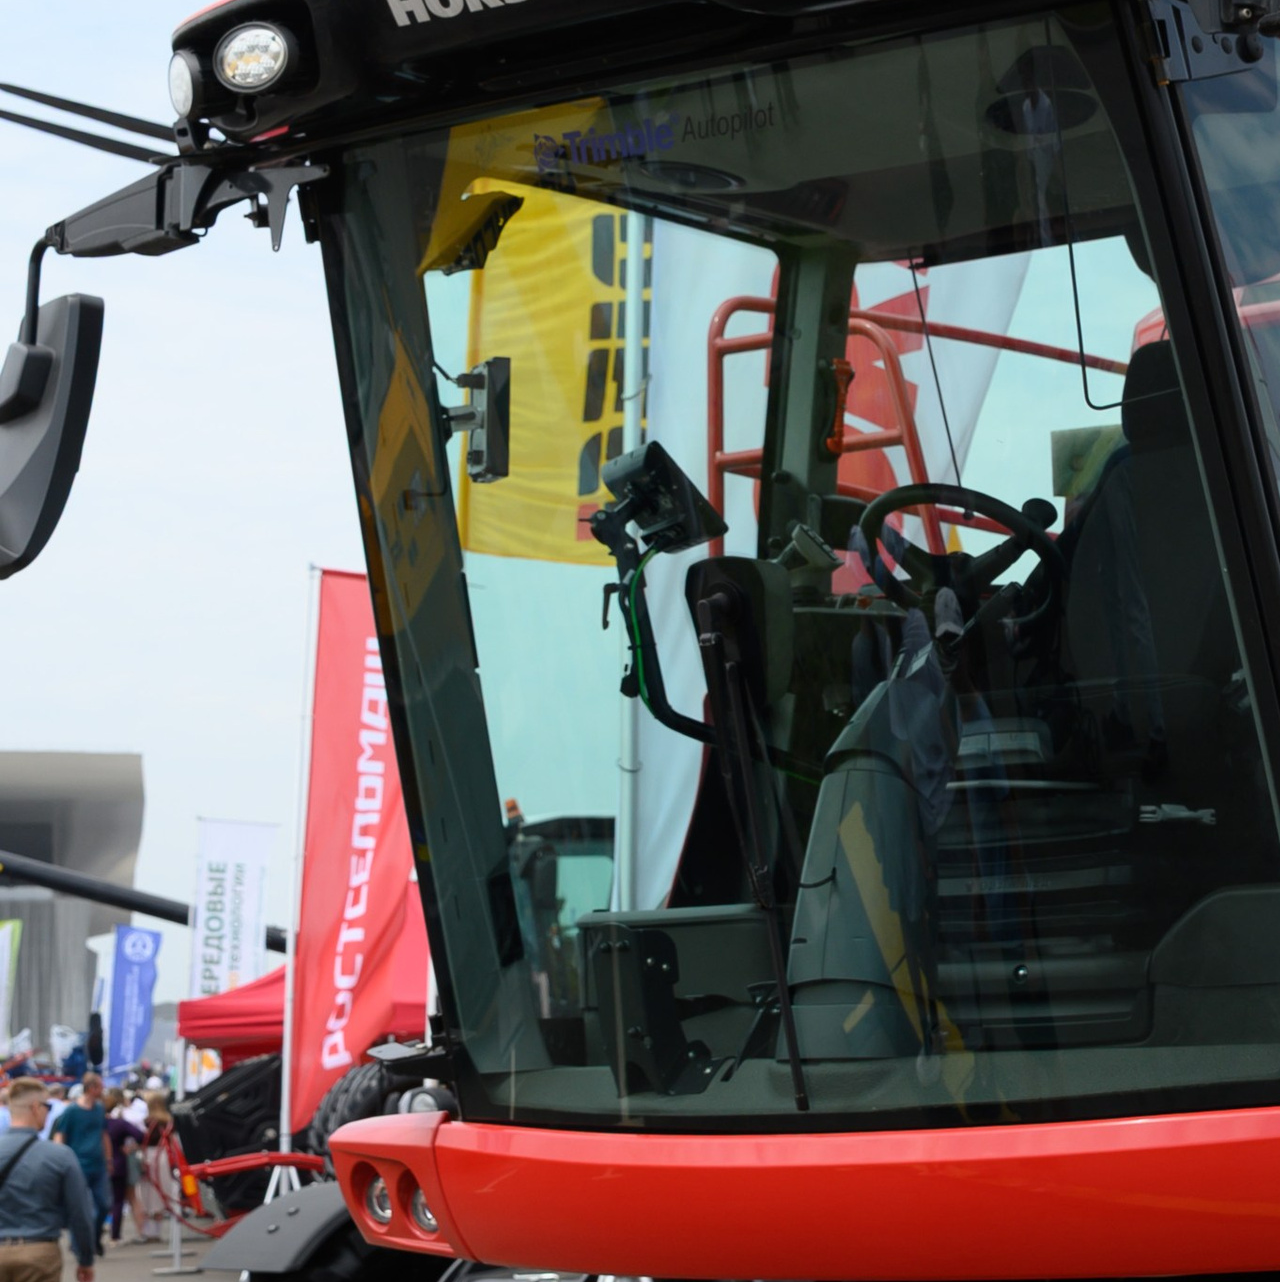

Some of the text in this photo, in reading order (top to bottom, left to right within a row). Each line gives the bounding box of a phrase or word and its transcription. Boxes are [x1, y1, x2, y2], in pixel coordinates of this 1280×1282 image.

[562, 102, 775, 165] Trimble Autopilot
[202, 861, 227, 996] ЕРЕДОВЫЕ
